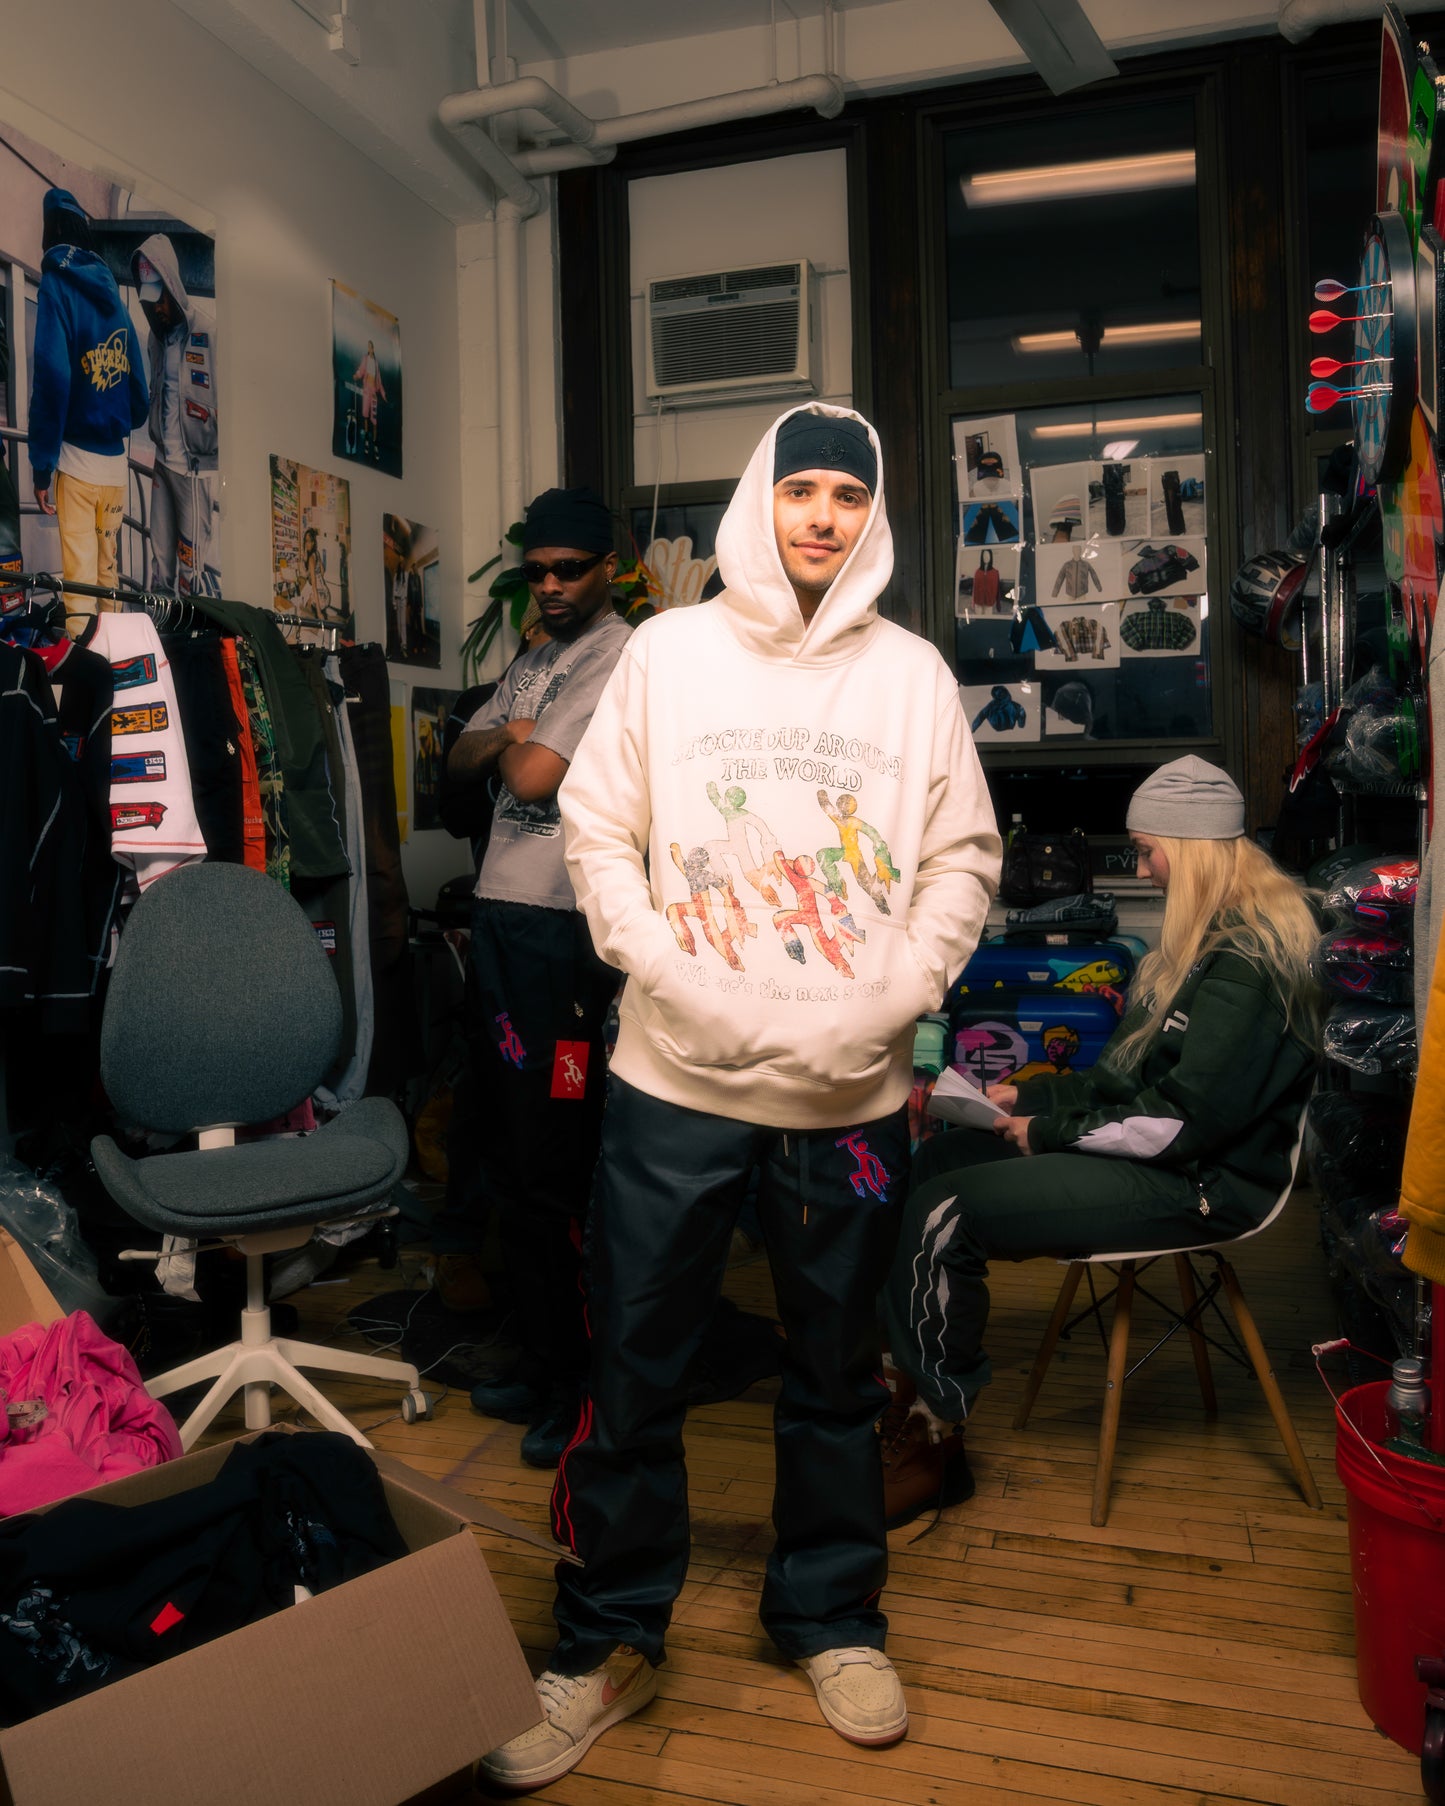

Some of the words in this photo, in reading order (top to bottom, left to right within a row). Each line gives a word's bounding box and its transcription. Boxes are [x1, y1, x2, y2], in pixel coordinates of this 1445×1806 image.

[721, 758, 767, 781] THE
[774, 758, 862, 792] WORLD
[814, 732, 905, 783] AROUND
